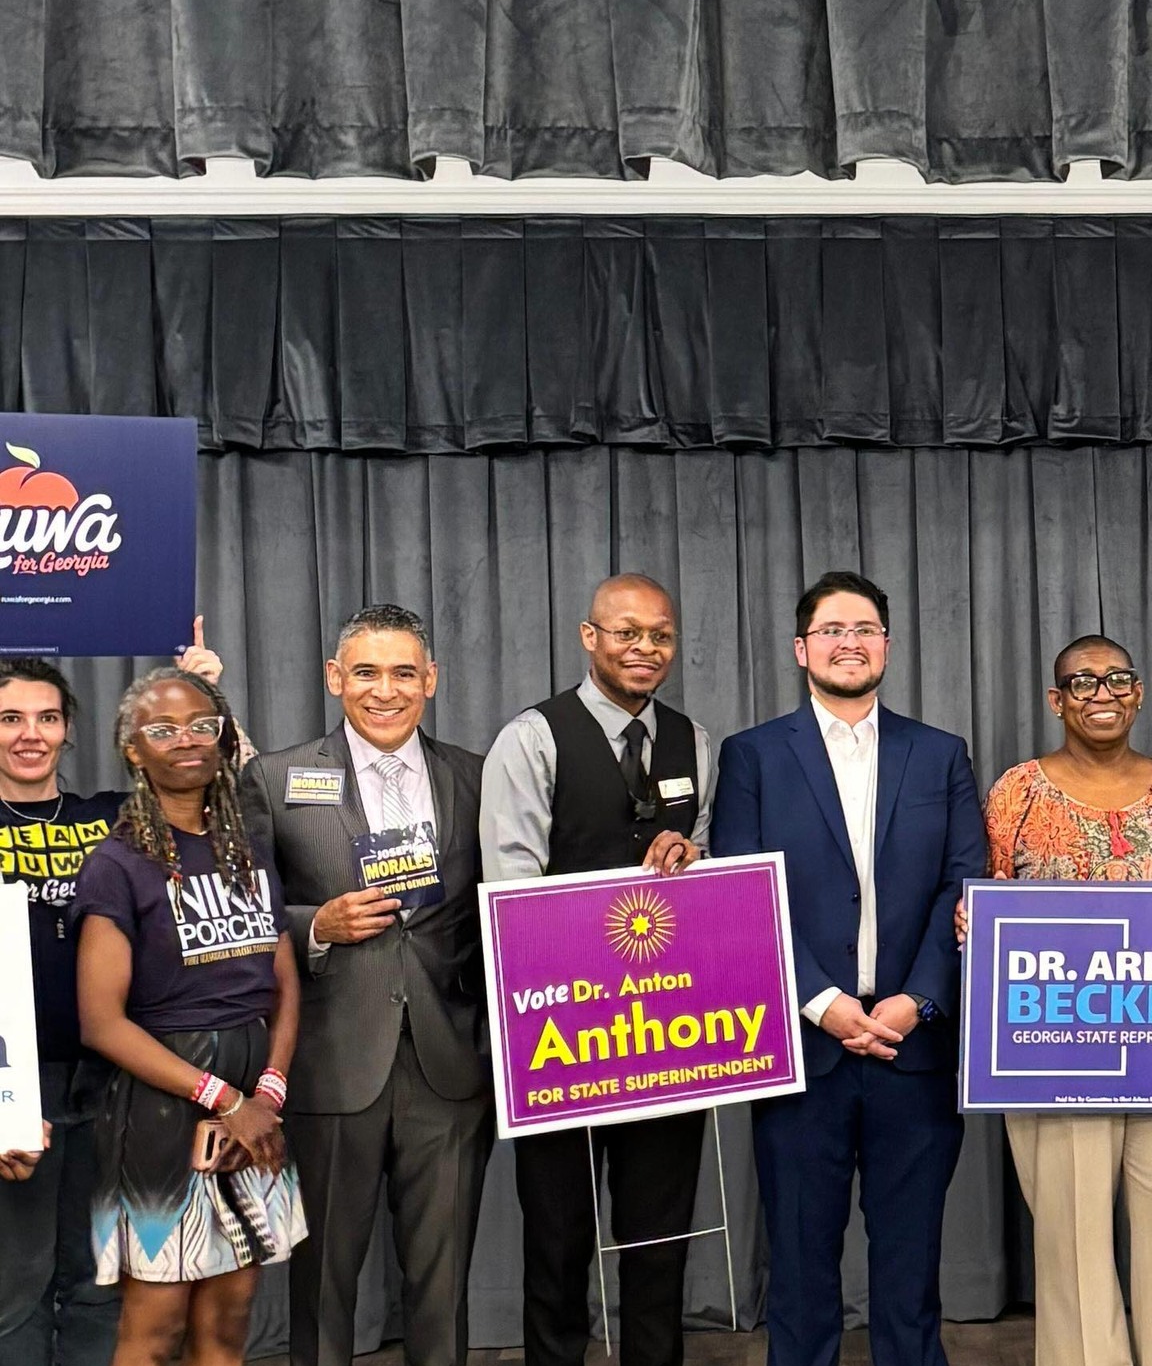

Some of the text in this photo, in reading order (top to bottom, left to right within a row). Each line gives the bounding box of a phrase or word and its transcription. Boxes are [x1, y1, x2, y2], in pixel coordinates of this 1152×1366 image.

[13, 551, 109, 576] for Georgia
[0, 823, 107, 845] EAM
[365, 853, 433, 880] MORALES
[406, 875, 441, 890] GENERAL
[1008, 950, 1078, 981] DR.
[512, 972, 692, 1014] Vote Dr. Anton
[528, 1001, 766, 1070] Anthony
[1012, 1030, 1074, 1044] GEORGIA
[1077, 1030, 1116, 1044] STATE
[527, 1055, 775, 1106] FOR STATE SUPERINTENDENT
